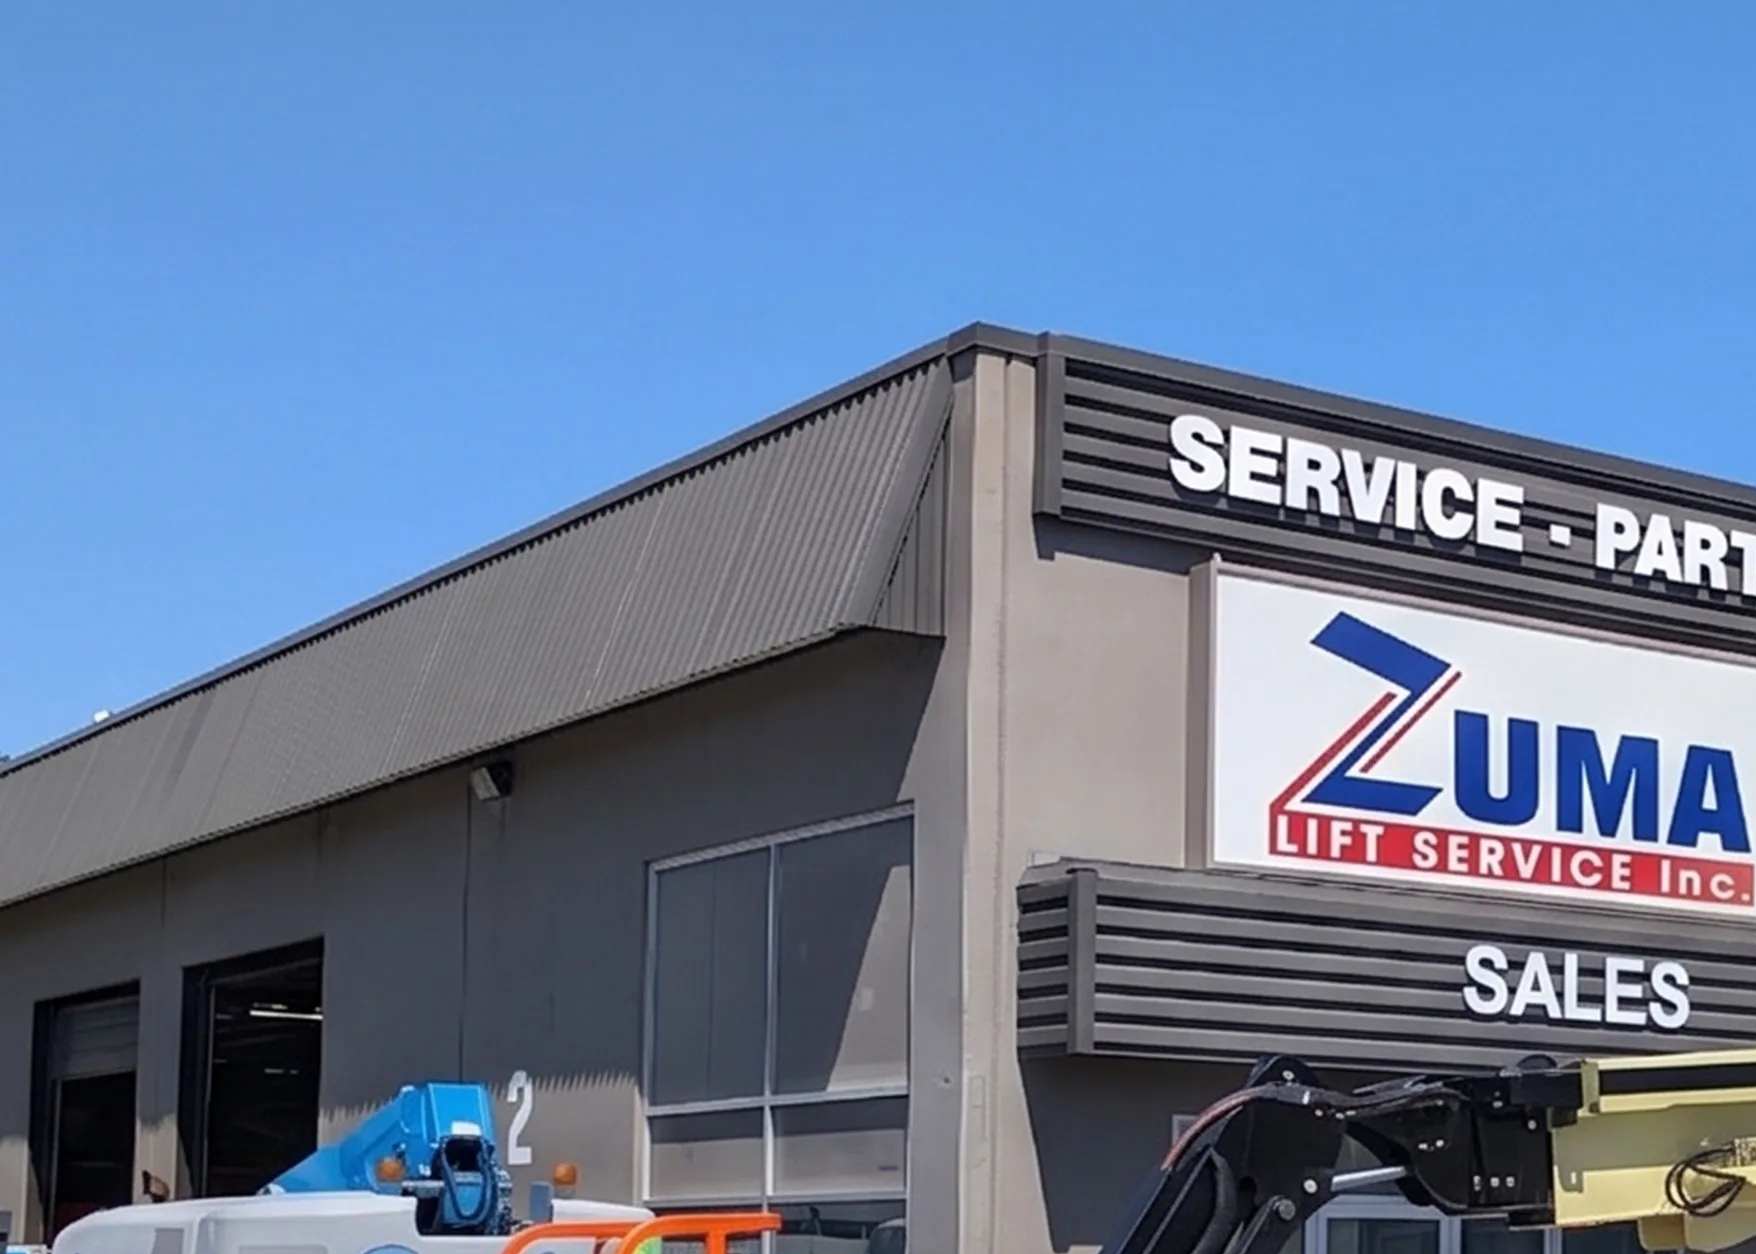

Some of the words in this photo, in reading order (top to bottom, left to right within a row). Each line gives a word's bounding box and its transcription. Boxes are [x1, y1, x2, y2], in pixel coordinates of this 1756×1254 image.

[1169, 413, 1525, 552] SERVICE
[1298, 611, 1752, 853] ZUMA
[1276, 814, 1386, 863] LIFT
[1412, 832, 1633, 892] SERVICE
[1661, 858, 1753, 902] Inc.
[1463, 944, 1691, 1029] SALES
[507, 1070, 532, 1165] 2
